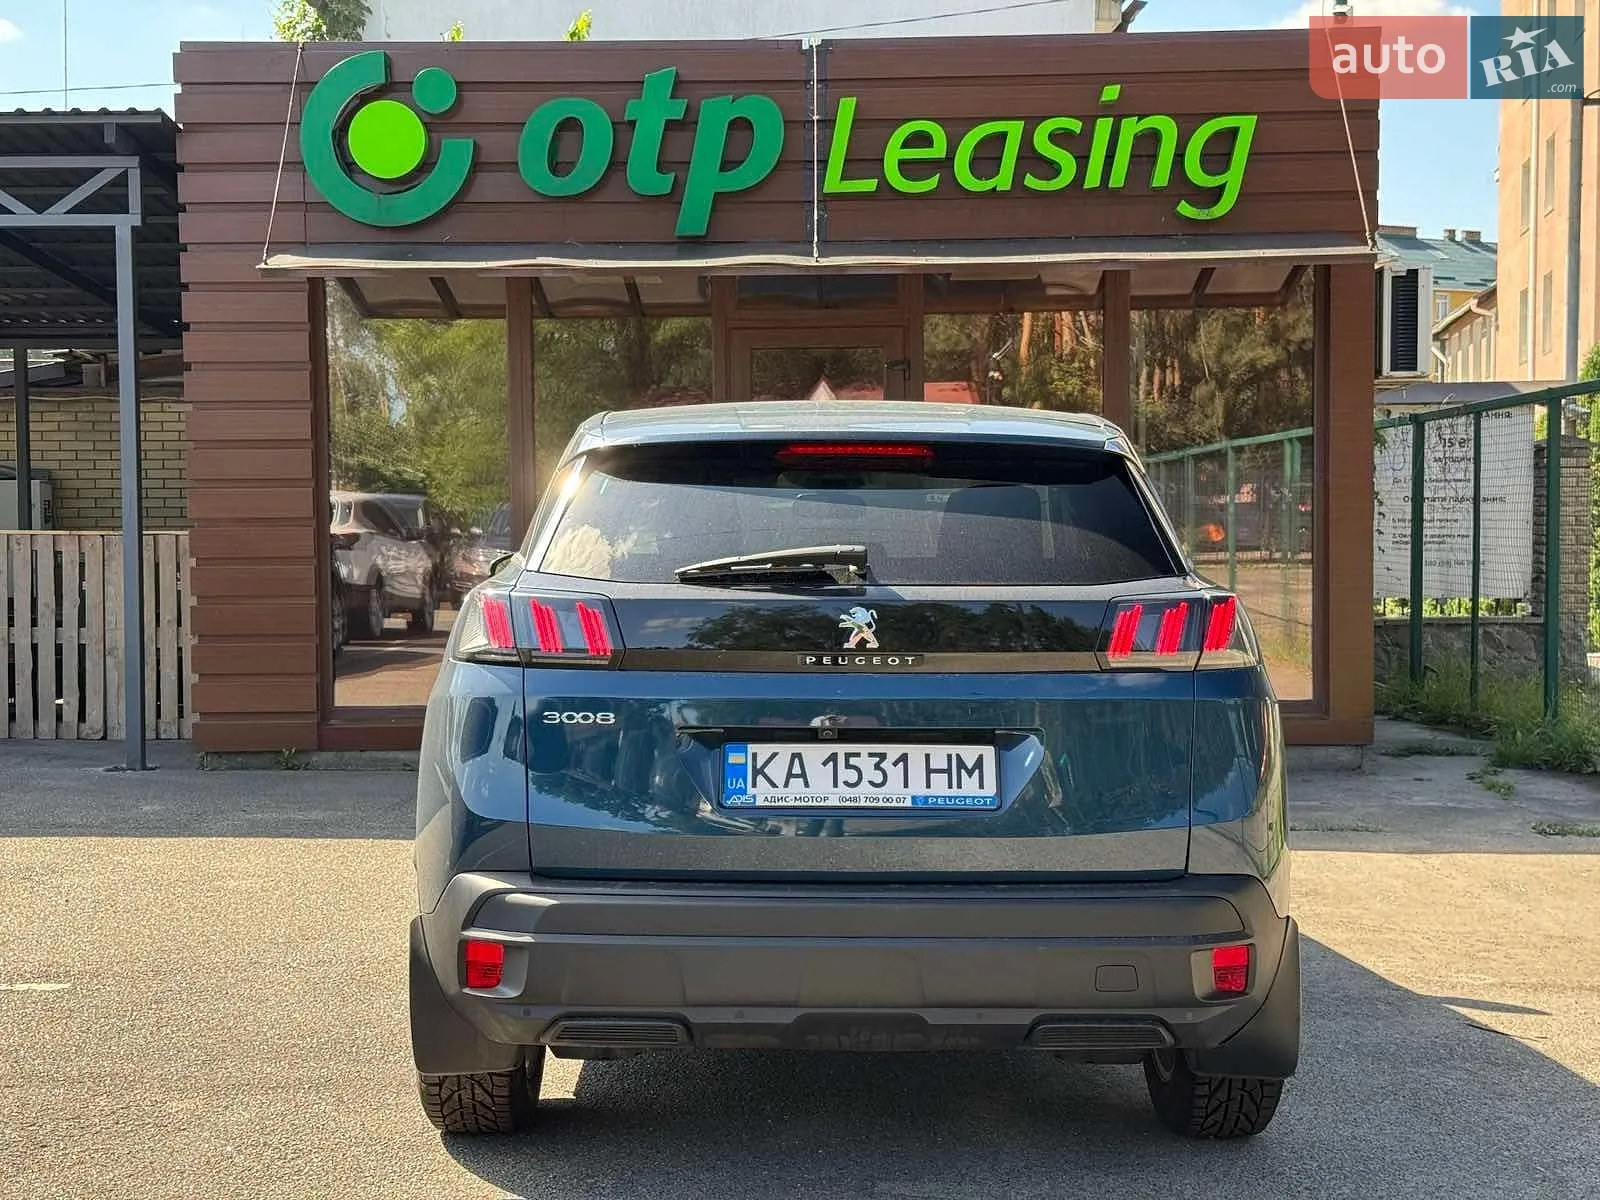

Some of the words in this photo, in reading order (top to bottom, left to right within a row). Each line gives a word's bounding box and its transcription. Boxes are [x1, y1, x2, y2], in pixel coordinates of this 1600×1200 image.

[518, 66, 786, 237] otp
[822, 84, 1258, 221] Leasing
[805, 656, 916, 665] PEUGEOT
[542, 711, 616, 724] 3008
[751, 752, 810, 788] KA
[821, 752, 909, 788] 1531
[925, 753, 985, 790] HM
[727, 778, 746, 789] UA
[763, 795, 829, 804] АДИС-МОТОР
[838, 795, 861, 805] (048)
[864, 796, 880, 804] 709
[882, 796, 893, 804] 00
[895, 796, 907, 804] 07
